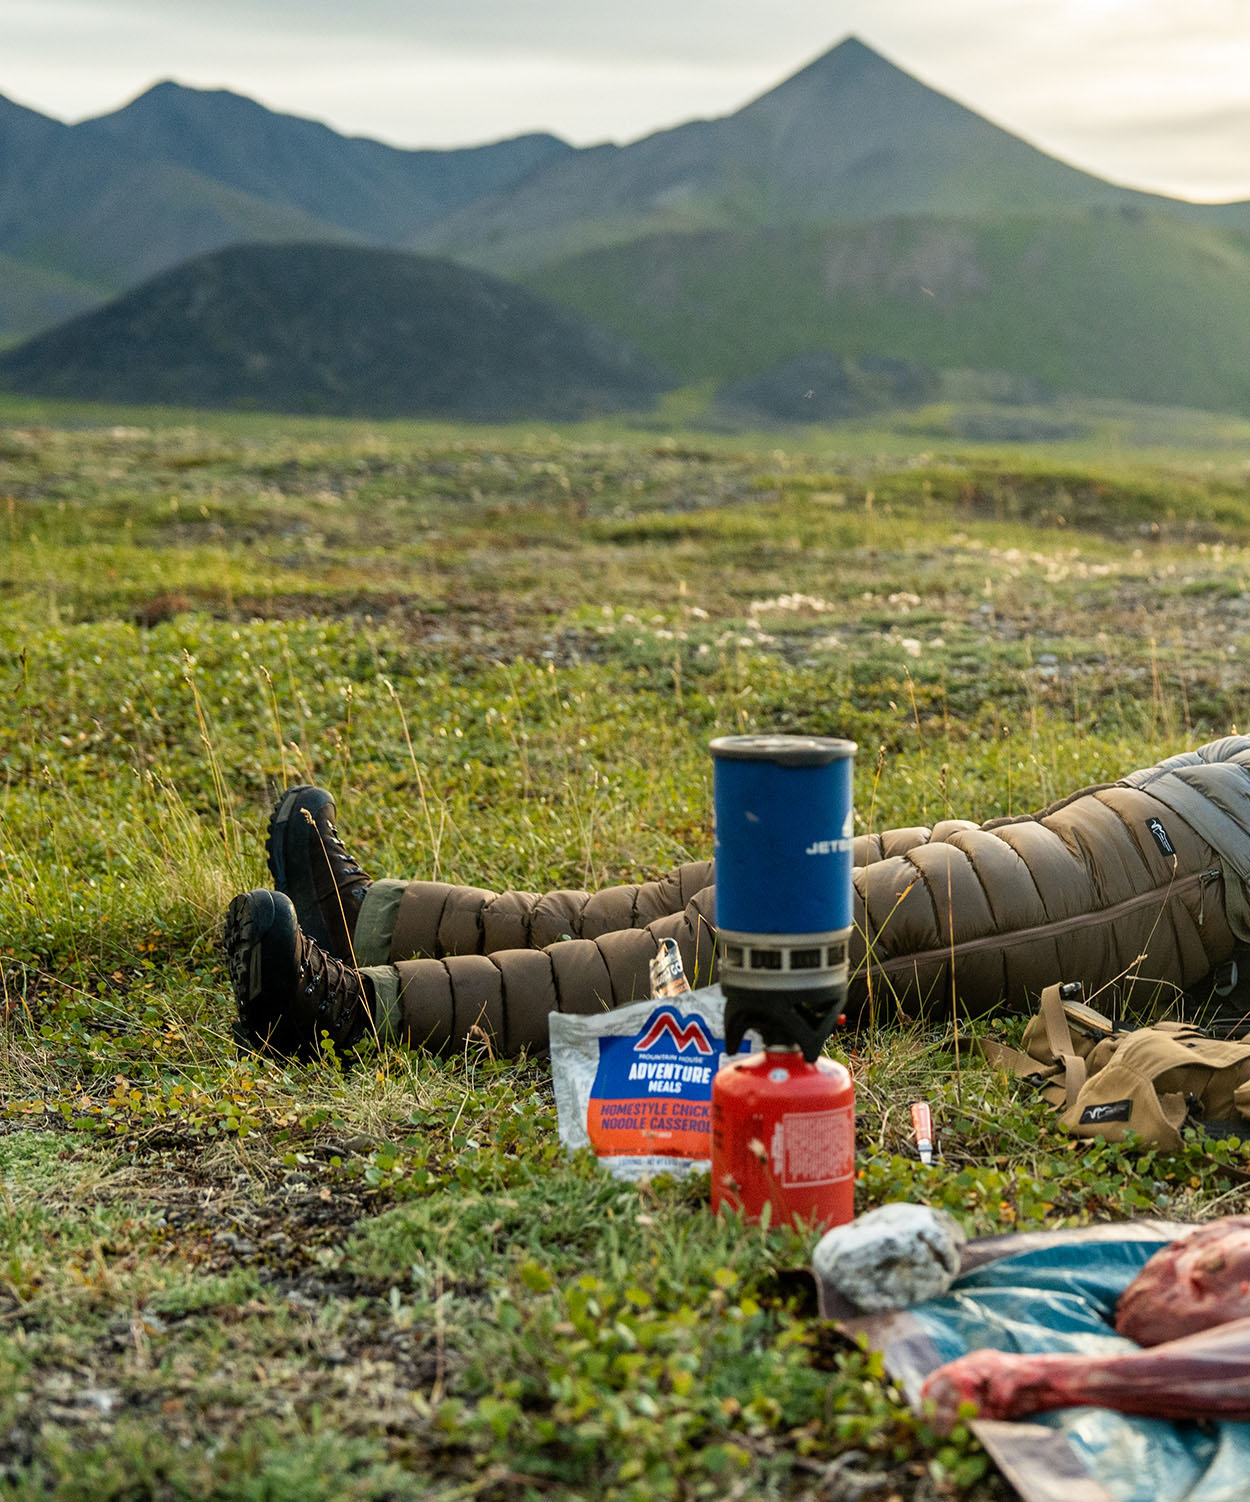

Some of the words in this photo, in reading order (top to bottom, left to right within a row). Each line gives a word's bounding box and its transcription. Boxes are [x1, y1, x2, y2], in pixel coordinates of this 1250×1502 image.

[638, 1053, 677, 1061] MOUNTAIN
[678, 1056, 704, 1064] HOUSE
[628, 1062, 712, 1084] ADVENTURE
[648, 1080, 682, 1093] MEALS
[600, 1102, 669, 1116] HOMESTYLE
[601, 1117, 647, 1130] NOODLE
